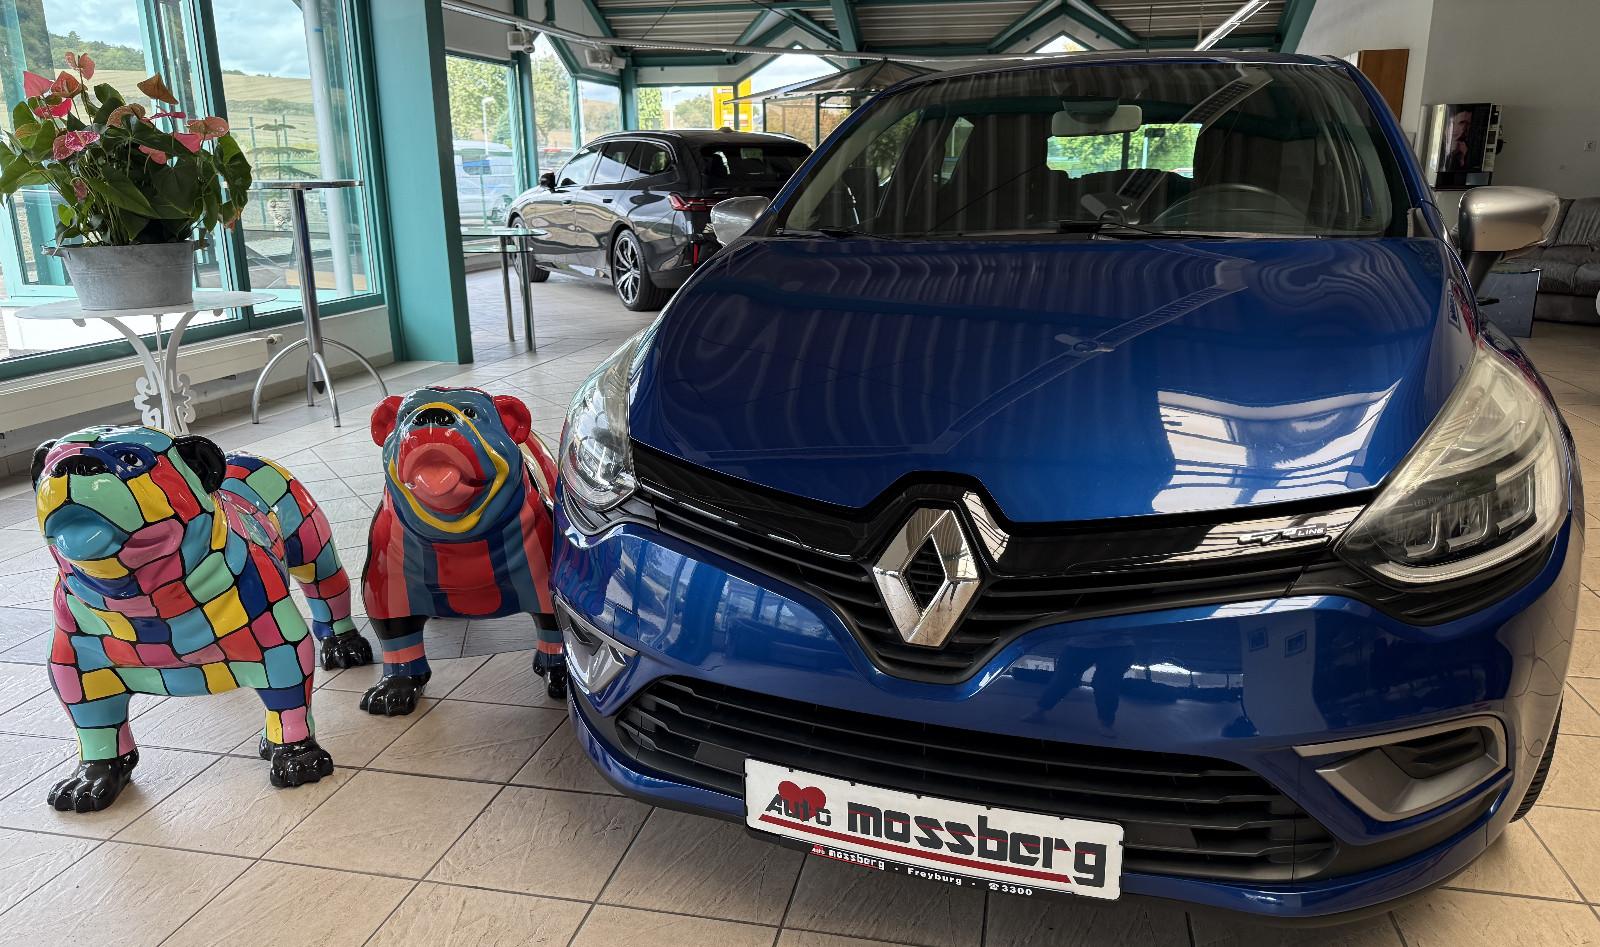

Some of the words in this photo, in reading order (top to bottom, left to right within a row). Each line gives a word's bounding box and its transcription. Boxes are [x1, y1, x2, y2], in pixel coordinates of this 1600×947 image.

[765, 793, 832, 827] Auto
[847, 801, 1107, 888] mossberg
[828, 848, 885, 871] mossberg
[907, 867, 962, 886] Freyburg
[1001, 884, 1033, 896] 3300
